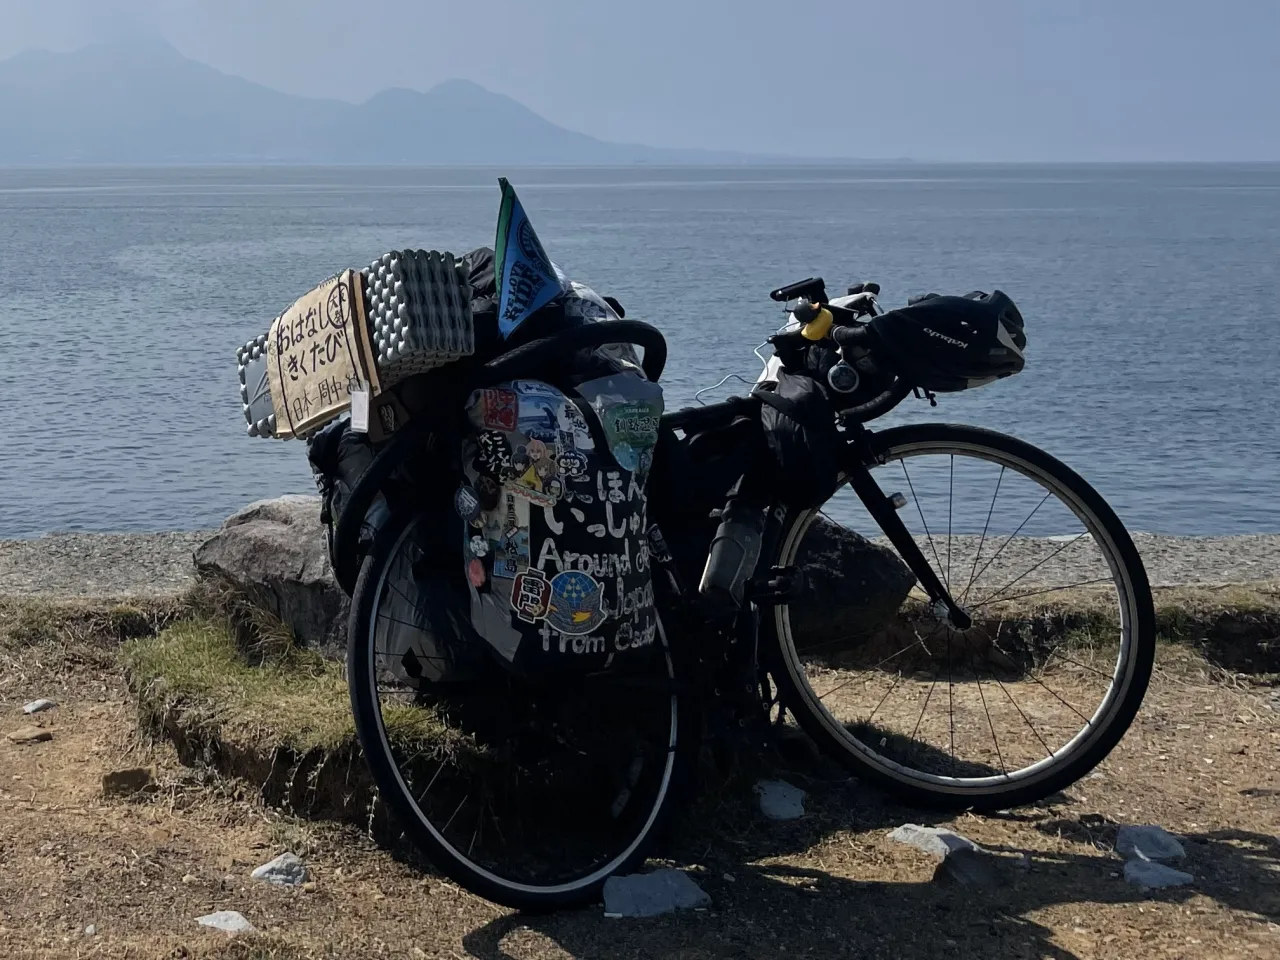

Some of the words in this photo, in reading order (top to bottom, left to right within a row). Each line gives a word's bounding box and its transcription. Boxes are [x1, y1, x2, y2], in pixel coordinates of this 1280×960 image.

[508, 259, 526, 296] LOVE
[508, 266, 543, 322] RIDE
[277, 302, 329, 355] おはなし
[923, 327, 969, 350] Kabuto
[287, 330, 345, 381] きくたび
[292, 376, 342, 422] 日本一周中
[536, 537, 632, 578] Around
[518, 577, 545, 609] 雷門
[538, 621, 607, 654] from
